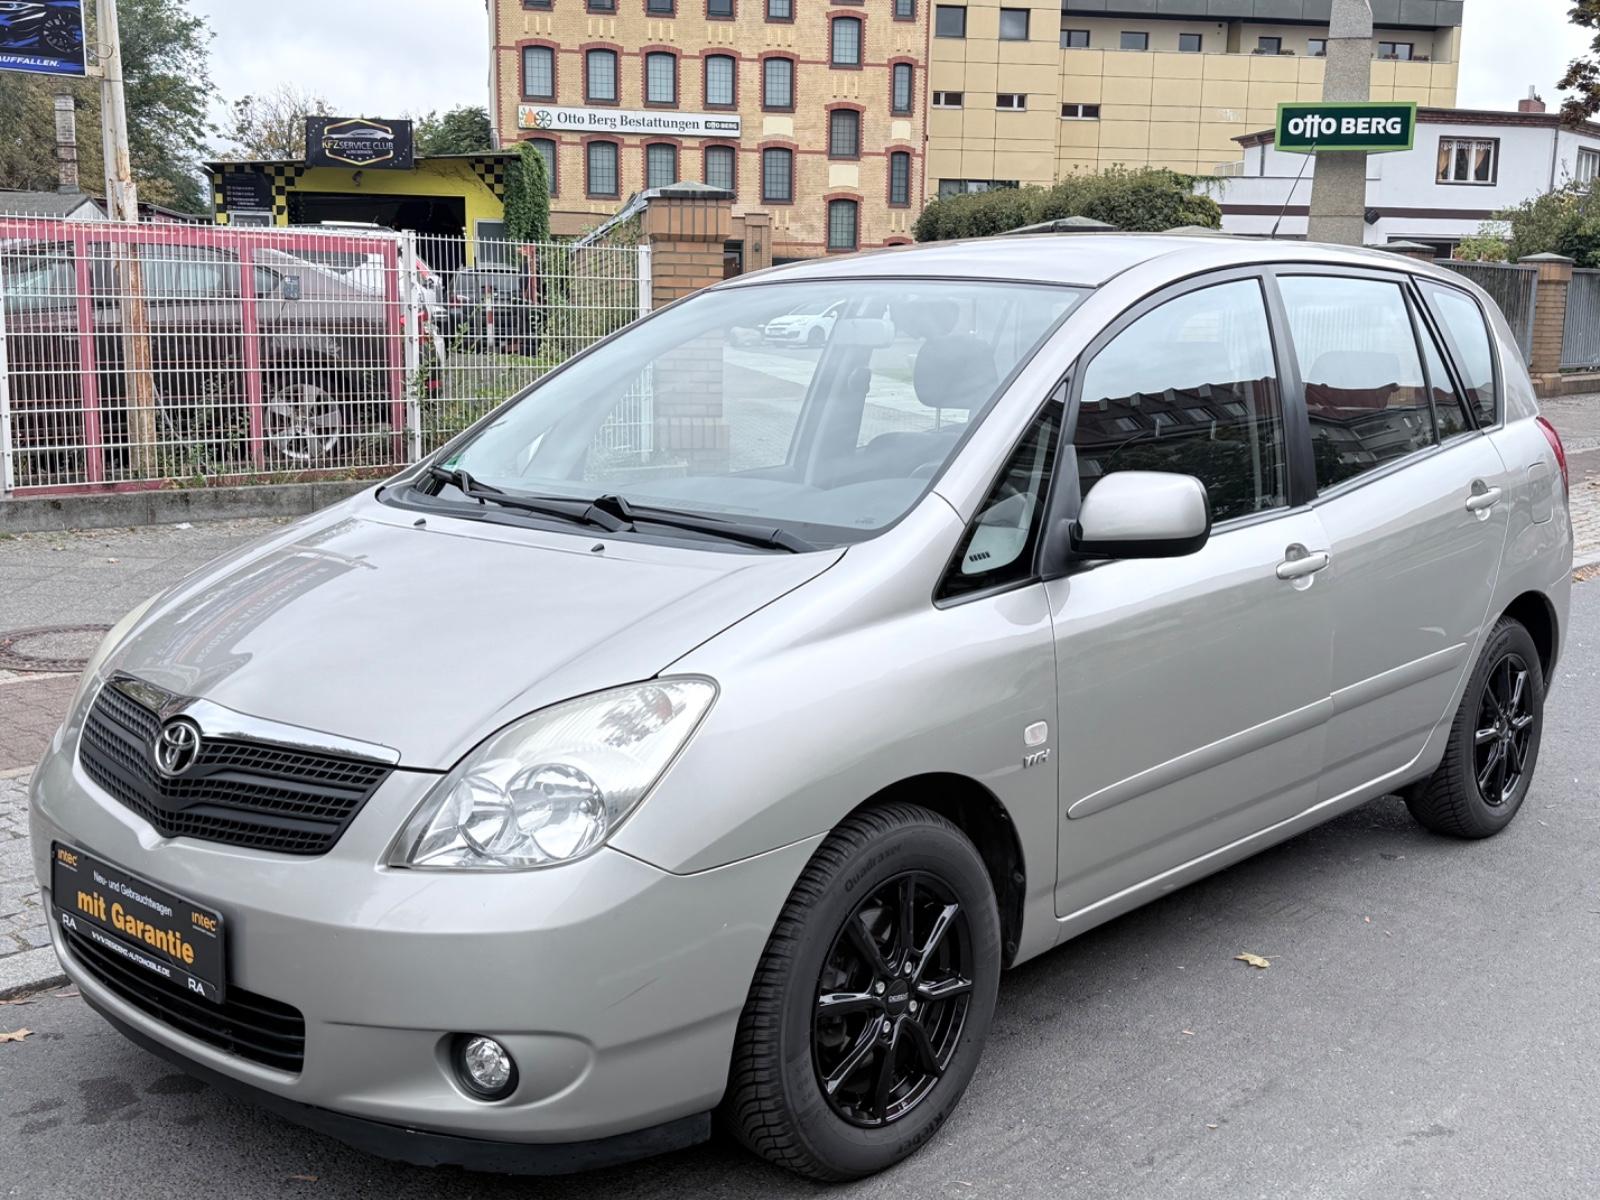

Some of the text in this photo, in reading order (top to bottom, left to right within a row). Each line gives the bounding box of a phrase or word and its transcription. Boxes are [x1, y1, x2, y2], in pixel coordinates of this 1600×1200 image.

[0, 55, 60, 67] UFFALLEN.
[557, 111, 700, 131] Otto Berg Bestattungen
[1340, 117, 1401, 134] BERG
[373, 141, 394, 150] CLUB
[108, 880, 120, 892] und
[120, 883, 173, 917] Gebrauchtwagen
[62, 913, 77, 930] RA
[77, 890, 195, 965] mit Garantie
[191, 911, 217, 932] intec
[187, 977, 206, 996] RA
